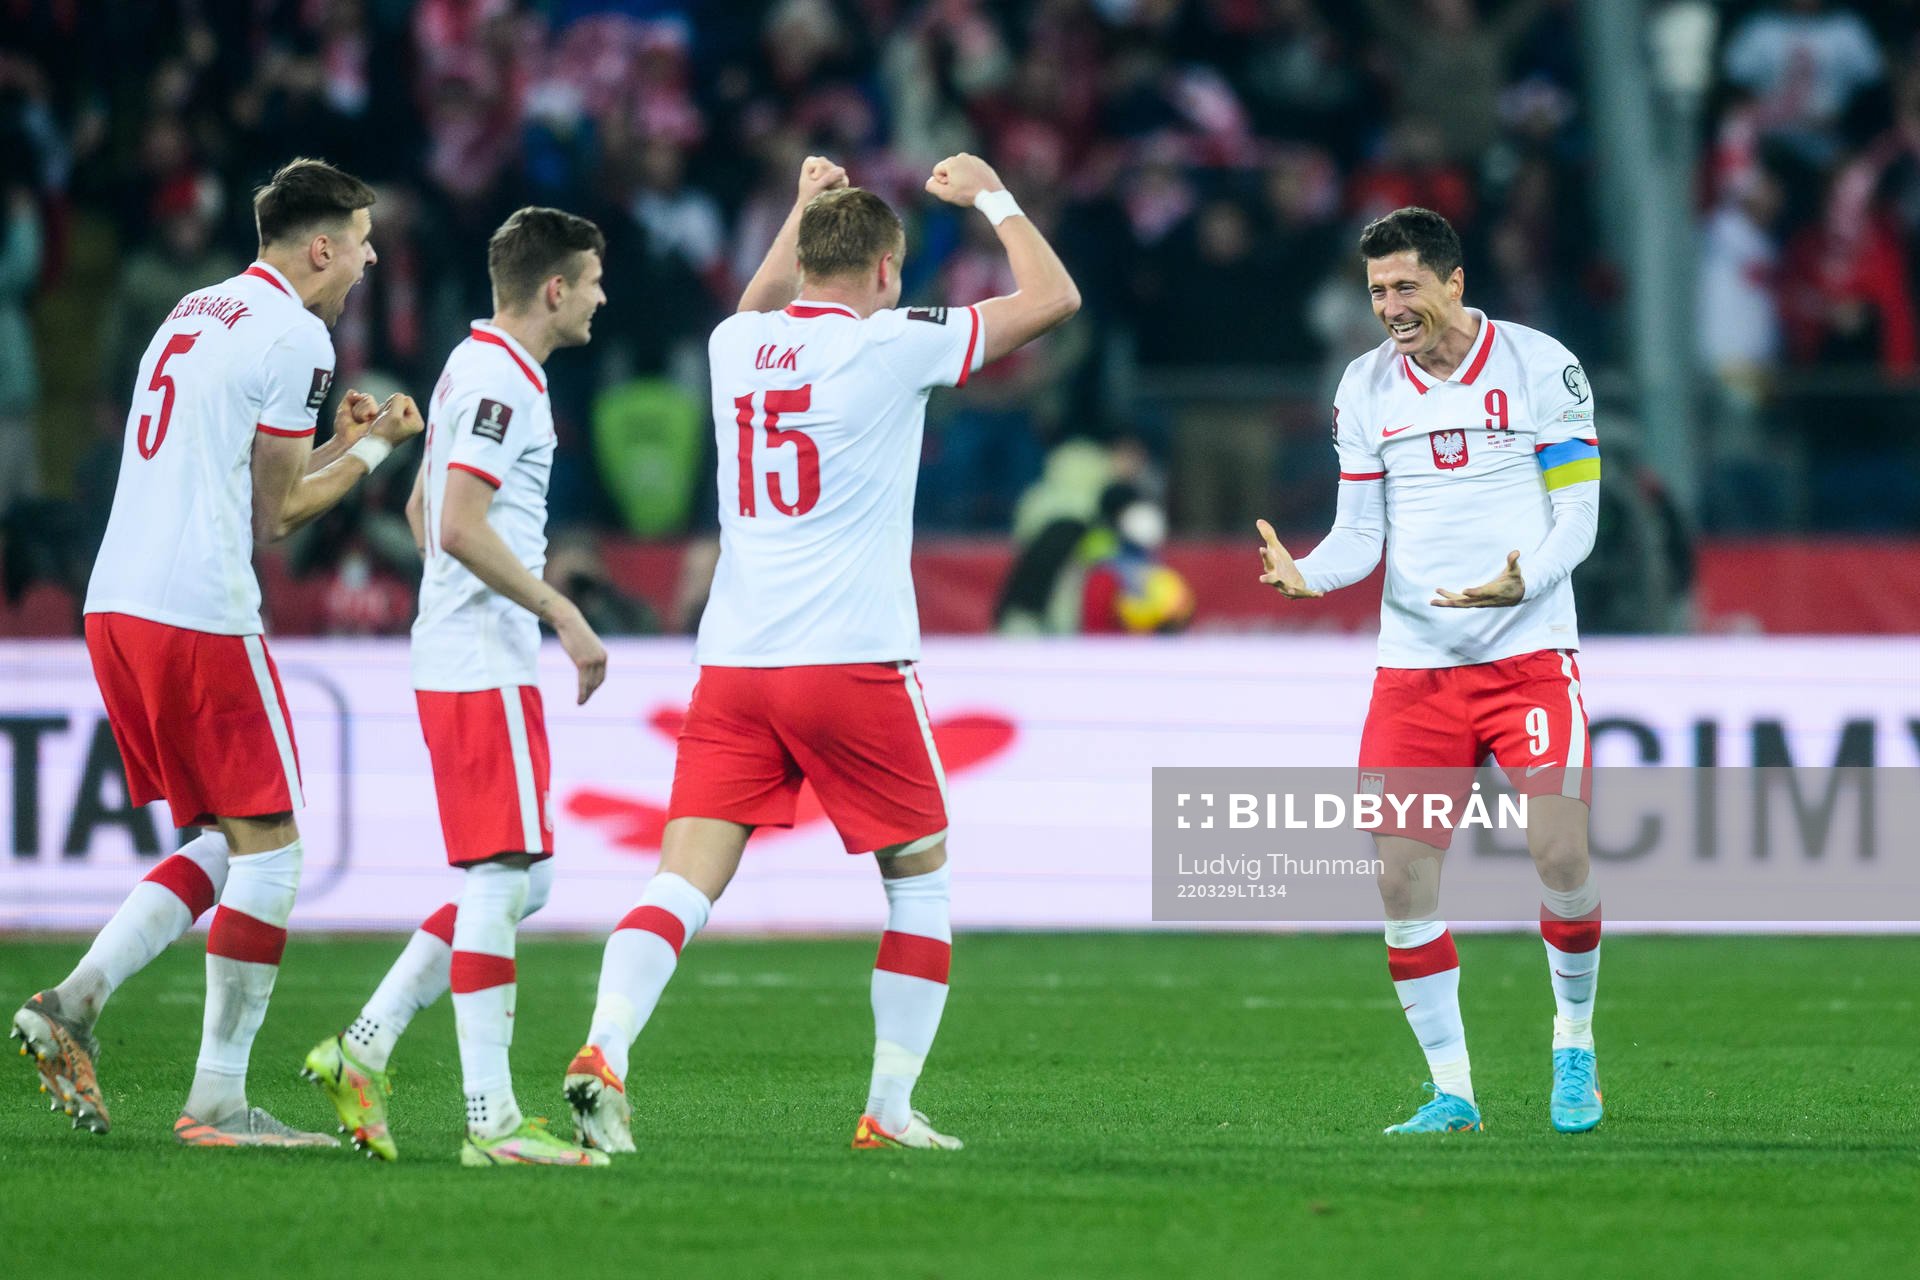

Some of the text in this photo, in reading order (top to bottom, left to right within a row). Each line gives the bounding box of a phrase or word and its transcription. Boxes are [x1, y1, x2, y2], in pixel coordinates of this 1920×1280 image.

[137, 330, 202, 461] 5
[734, 384, 820, 517] 15
[1484, 389, 1508, 430] 9
[0, 713, 206, 859] TA
[1525, 707, 1549, 756] 9
